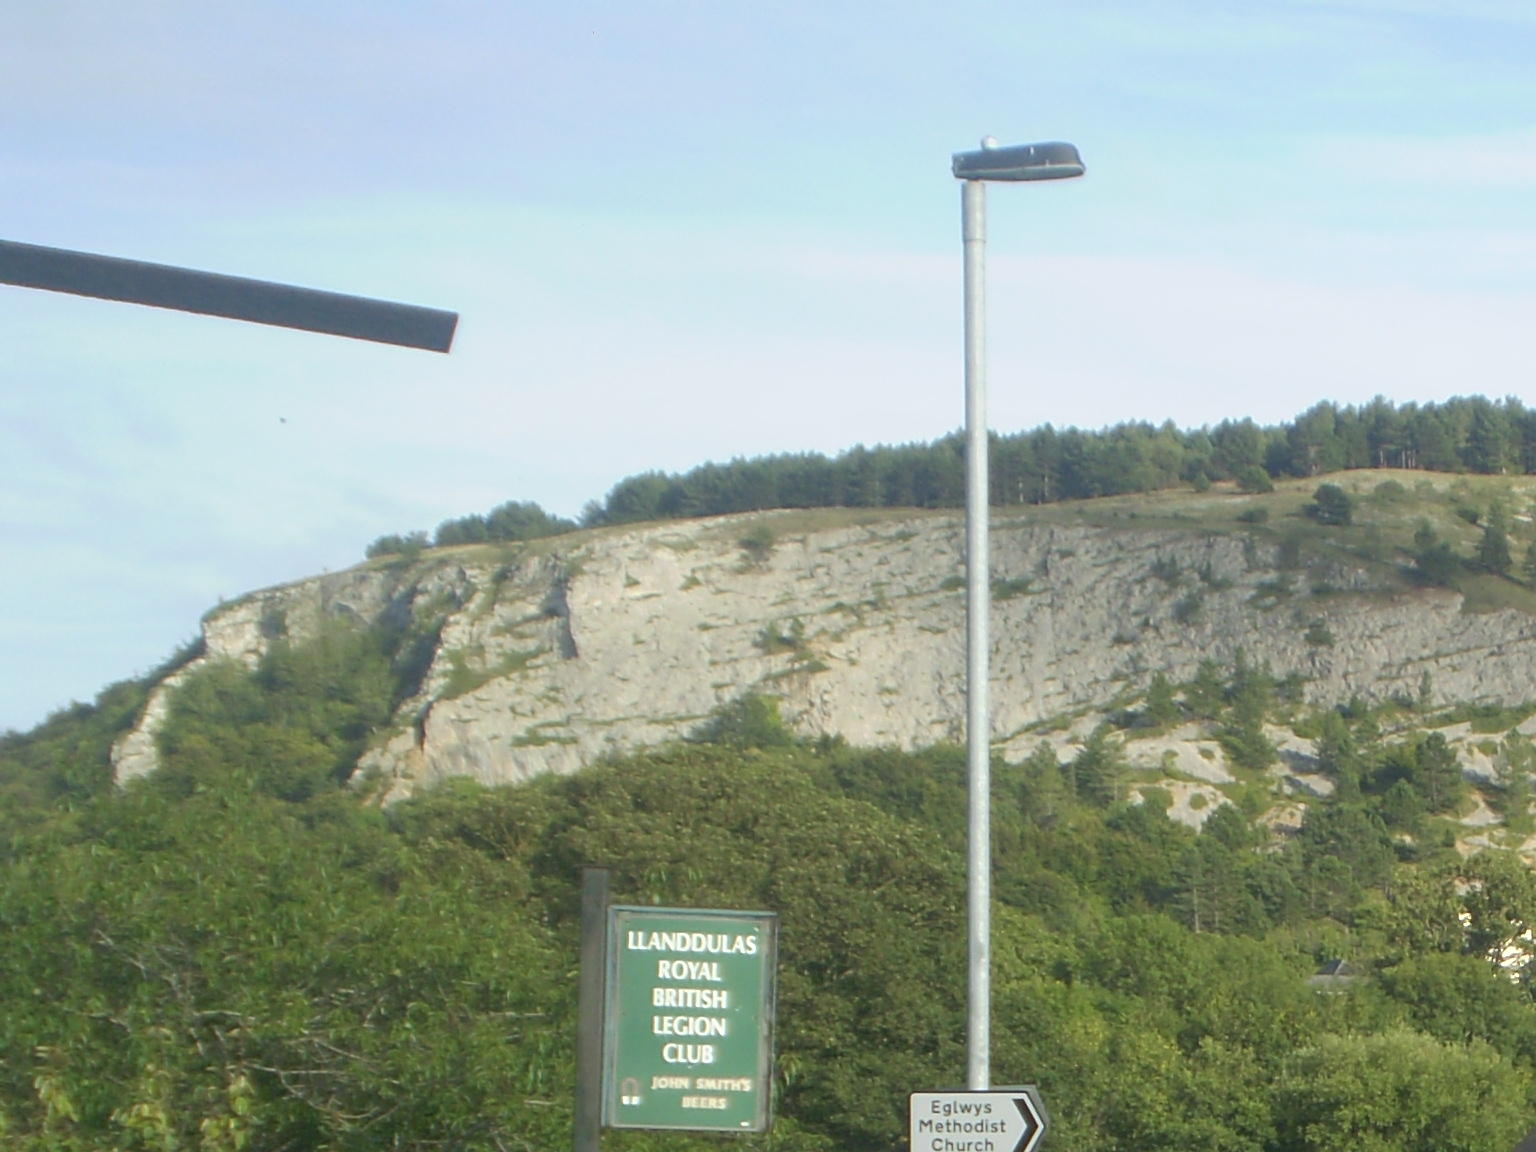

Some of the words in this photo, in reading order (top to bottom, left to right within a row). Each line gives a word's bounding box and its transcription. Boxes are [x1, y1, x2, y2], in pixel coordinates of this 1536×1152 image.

[628, 931, 757, 954] LLANDDULAS
[658, 960, 722, 981] ROYAL
[653, 988, 727, 1009] BRITISH
[653, 1016, 726, 1036] LEGION
[662, 1043, 714, 1064] CLUB
[651, 1076, 690, 1090] JOHN
[695, 1078, 752, 1092] SMITH'S
[681, 1097, 727, 1110] BEERS
[931, 1100, 992, 1116] Eglwys
[919, 1119, 1007, 1133] Methodist
[931, 1138, 994, 1152] Church
